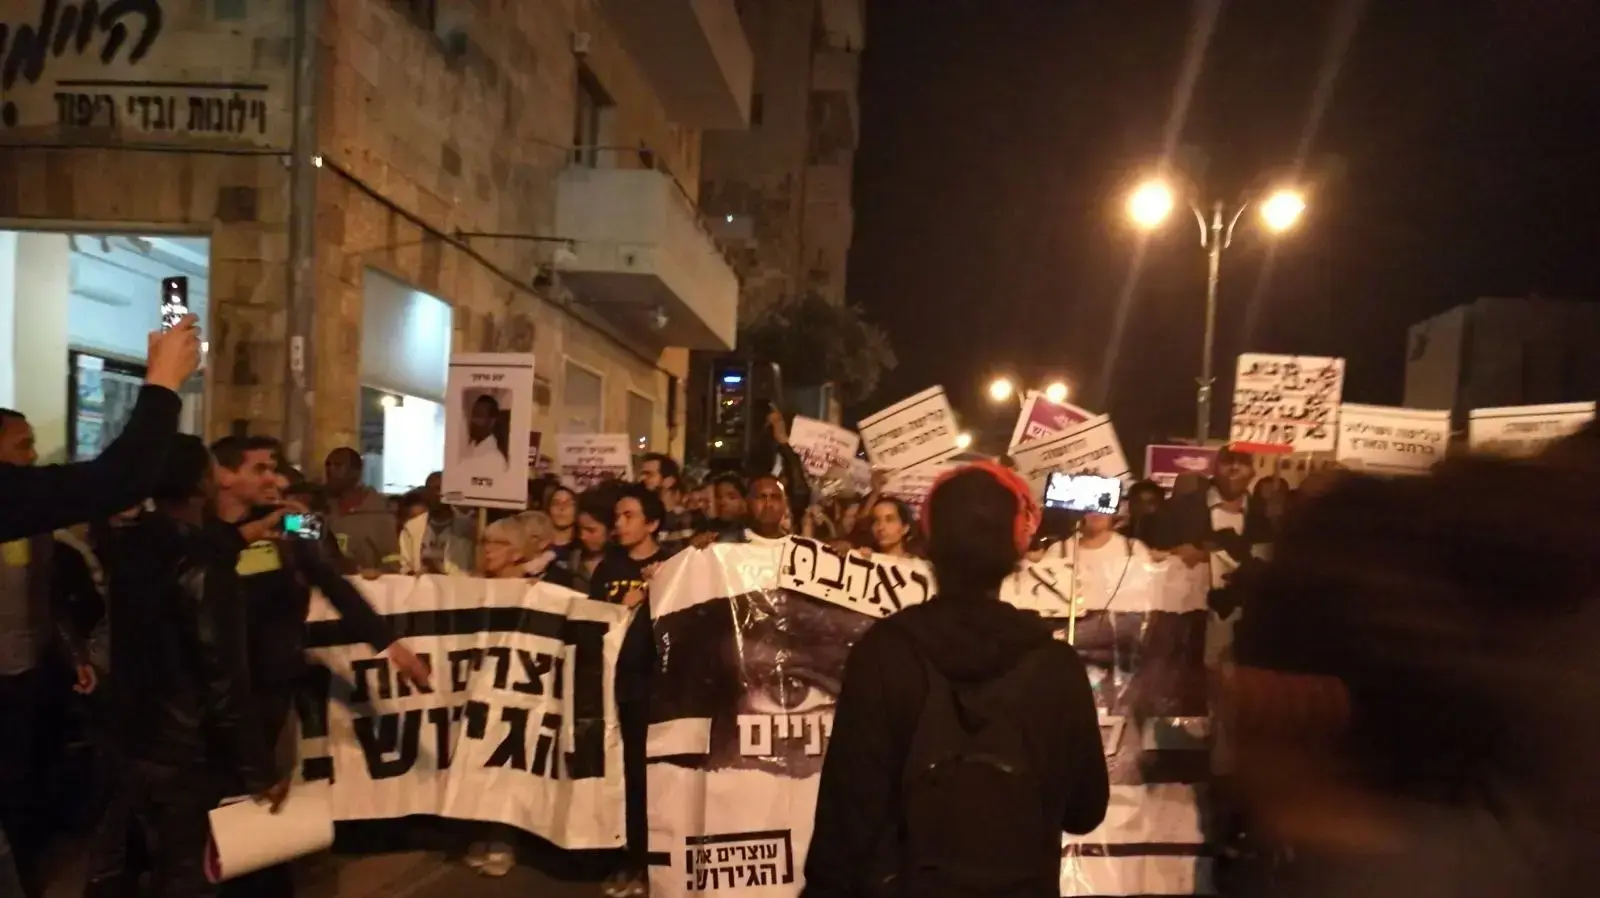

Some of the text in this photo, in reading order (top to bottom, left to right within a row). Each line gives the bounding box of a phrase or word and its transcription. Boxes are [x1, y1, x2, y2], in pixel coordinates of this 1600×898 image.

[128, 96, 175, 131] ובדי
[1350, 437, 1435, 456] ברחבי הארץ
[716, 844, 778, 863] עוצרים
